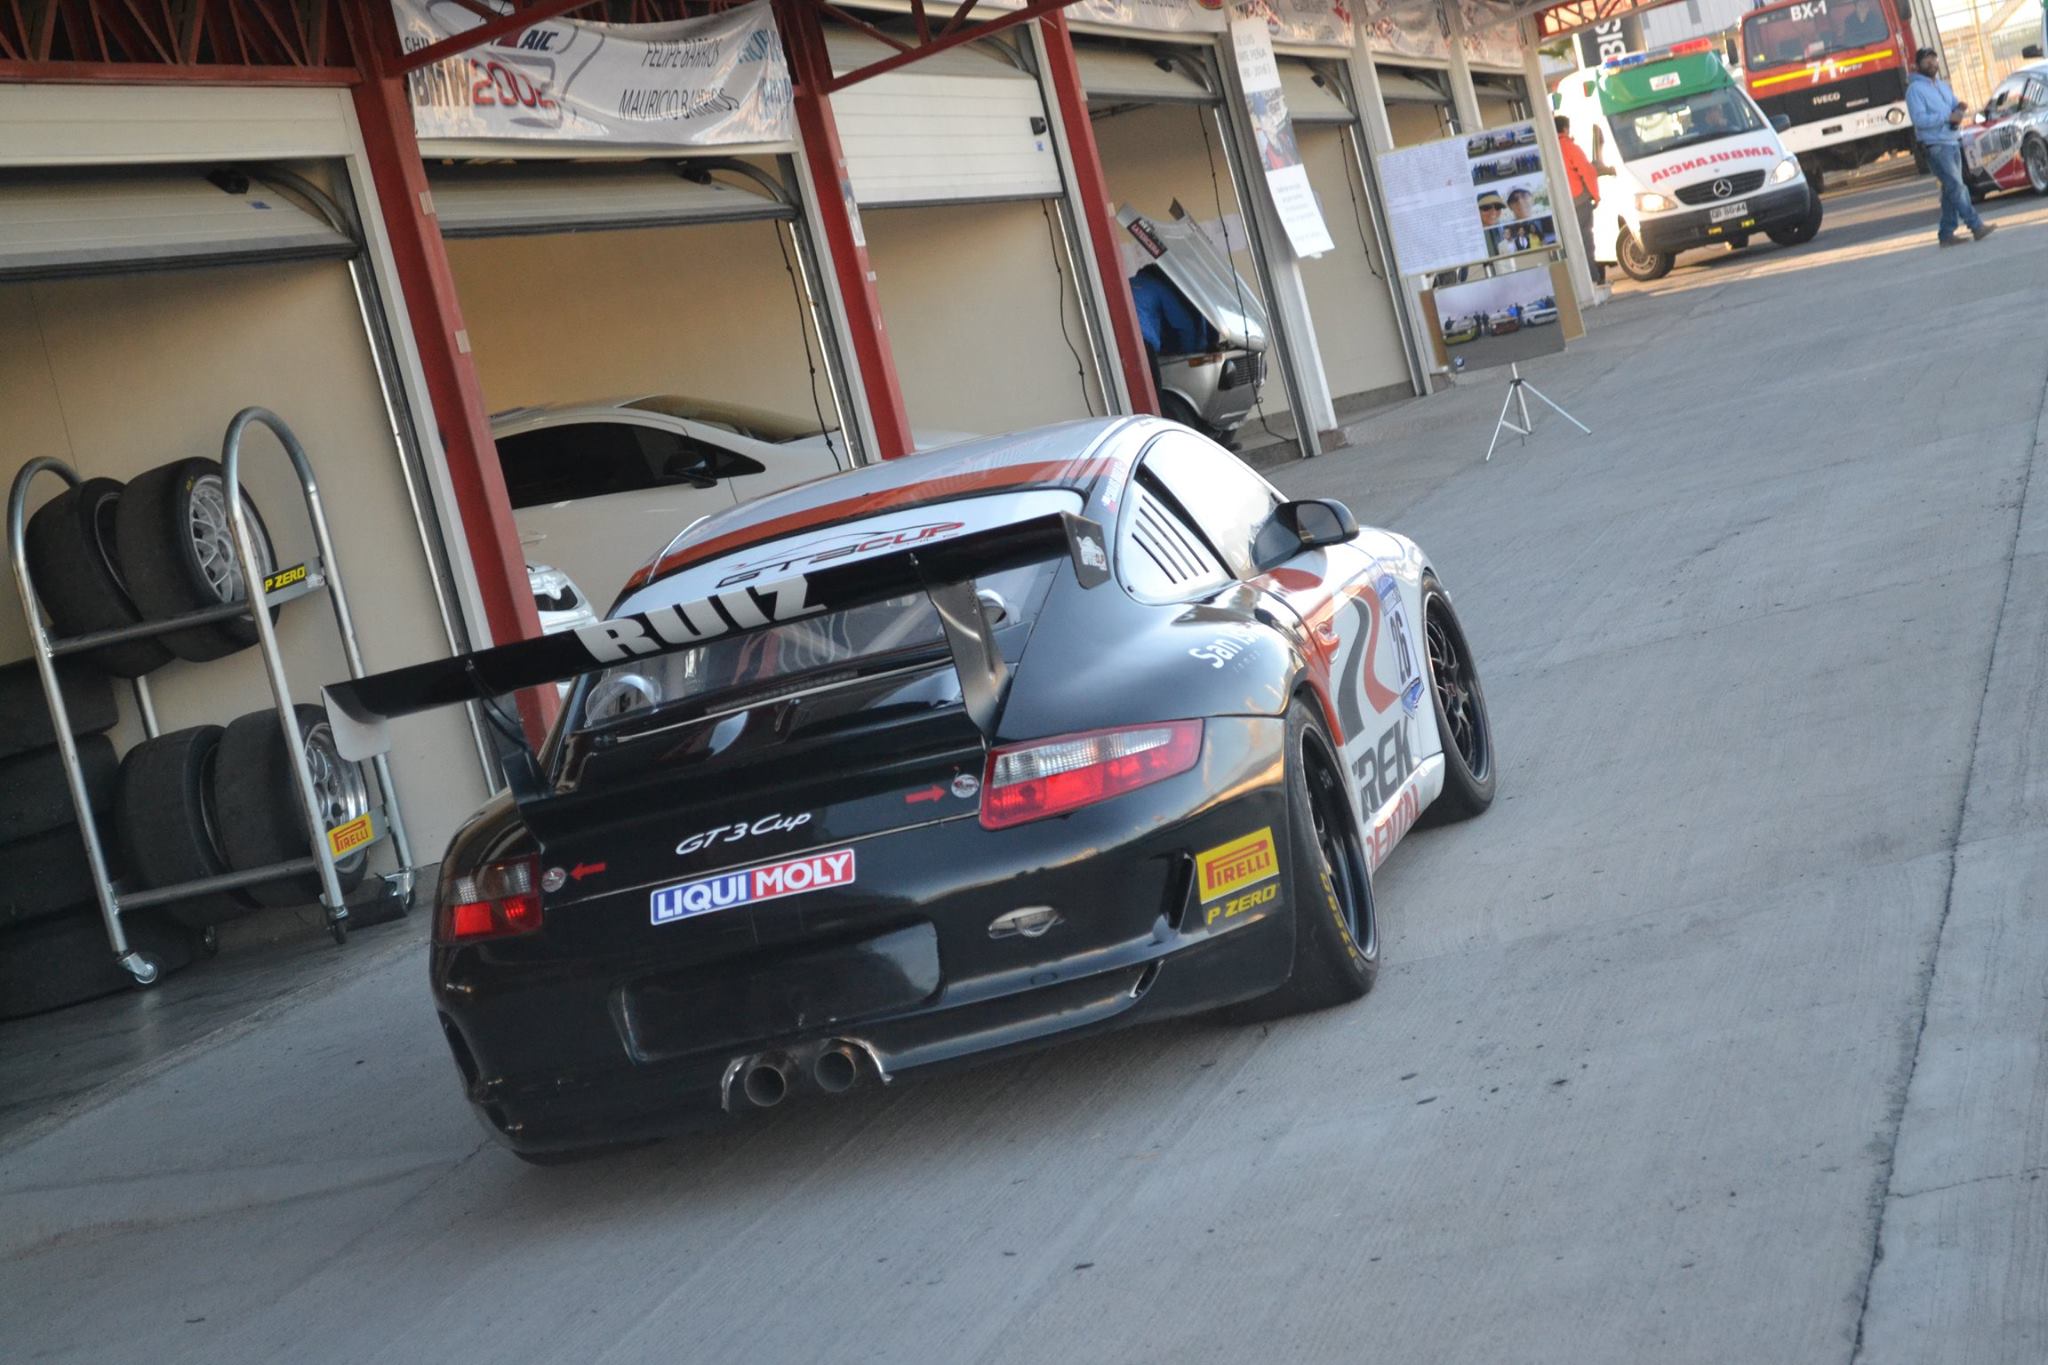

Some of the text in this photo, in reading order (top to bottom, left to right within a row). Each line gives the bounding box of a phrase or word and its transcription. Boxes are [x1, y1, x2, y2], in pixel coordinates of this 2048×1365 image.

[1790, 0, 1828, 22] BX-1
[519, 29, 560, 51] AIC
[641, 40, 682, 68] FELIPE
[1806, 58, 1838, 84] 71
[618, 88, 679, 121] MAURICIO
[1813, 92, 1841, 106] IVECO
[264, 578, 273, 593] P
[274, 565, 307, 589] ZERO
[575, 572, 827, 664] RUIZ
[1188, 637, 1244, 670] San
[332, 818, 370, 851] PIRELLI
[1205, 838, 1271, 890] PIRELLI
[656, 853, 850, 920] LIQUI MOLY
[1206, 883, 1279, 926] P ZERO
